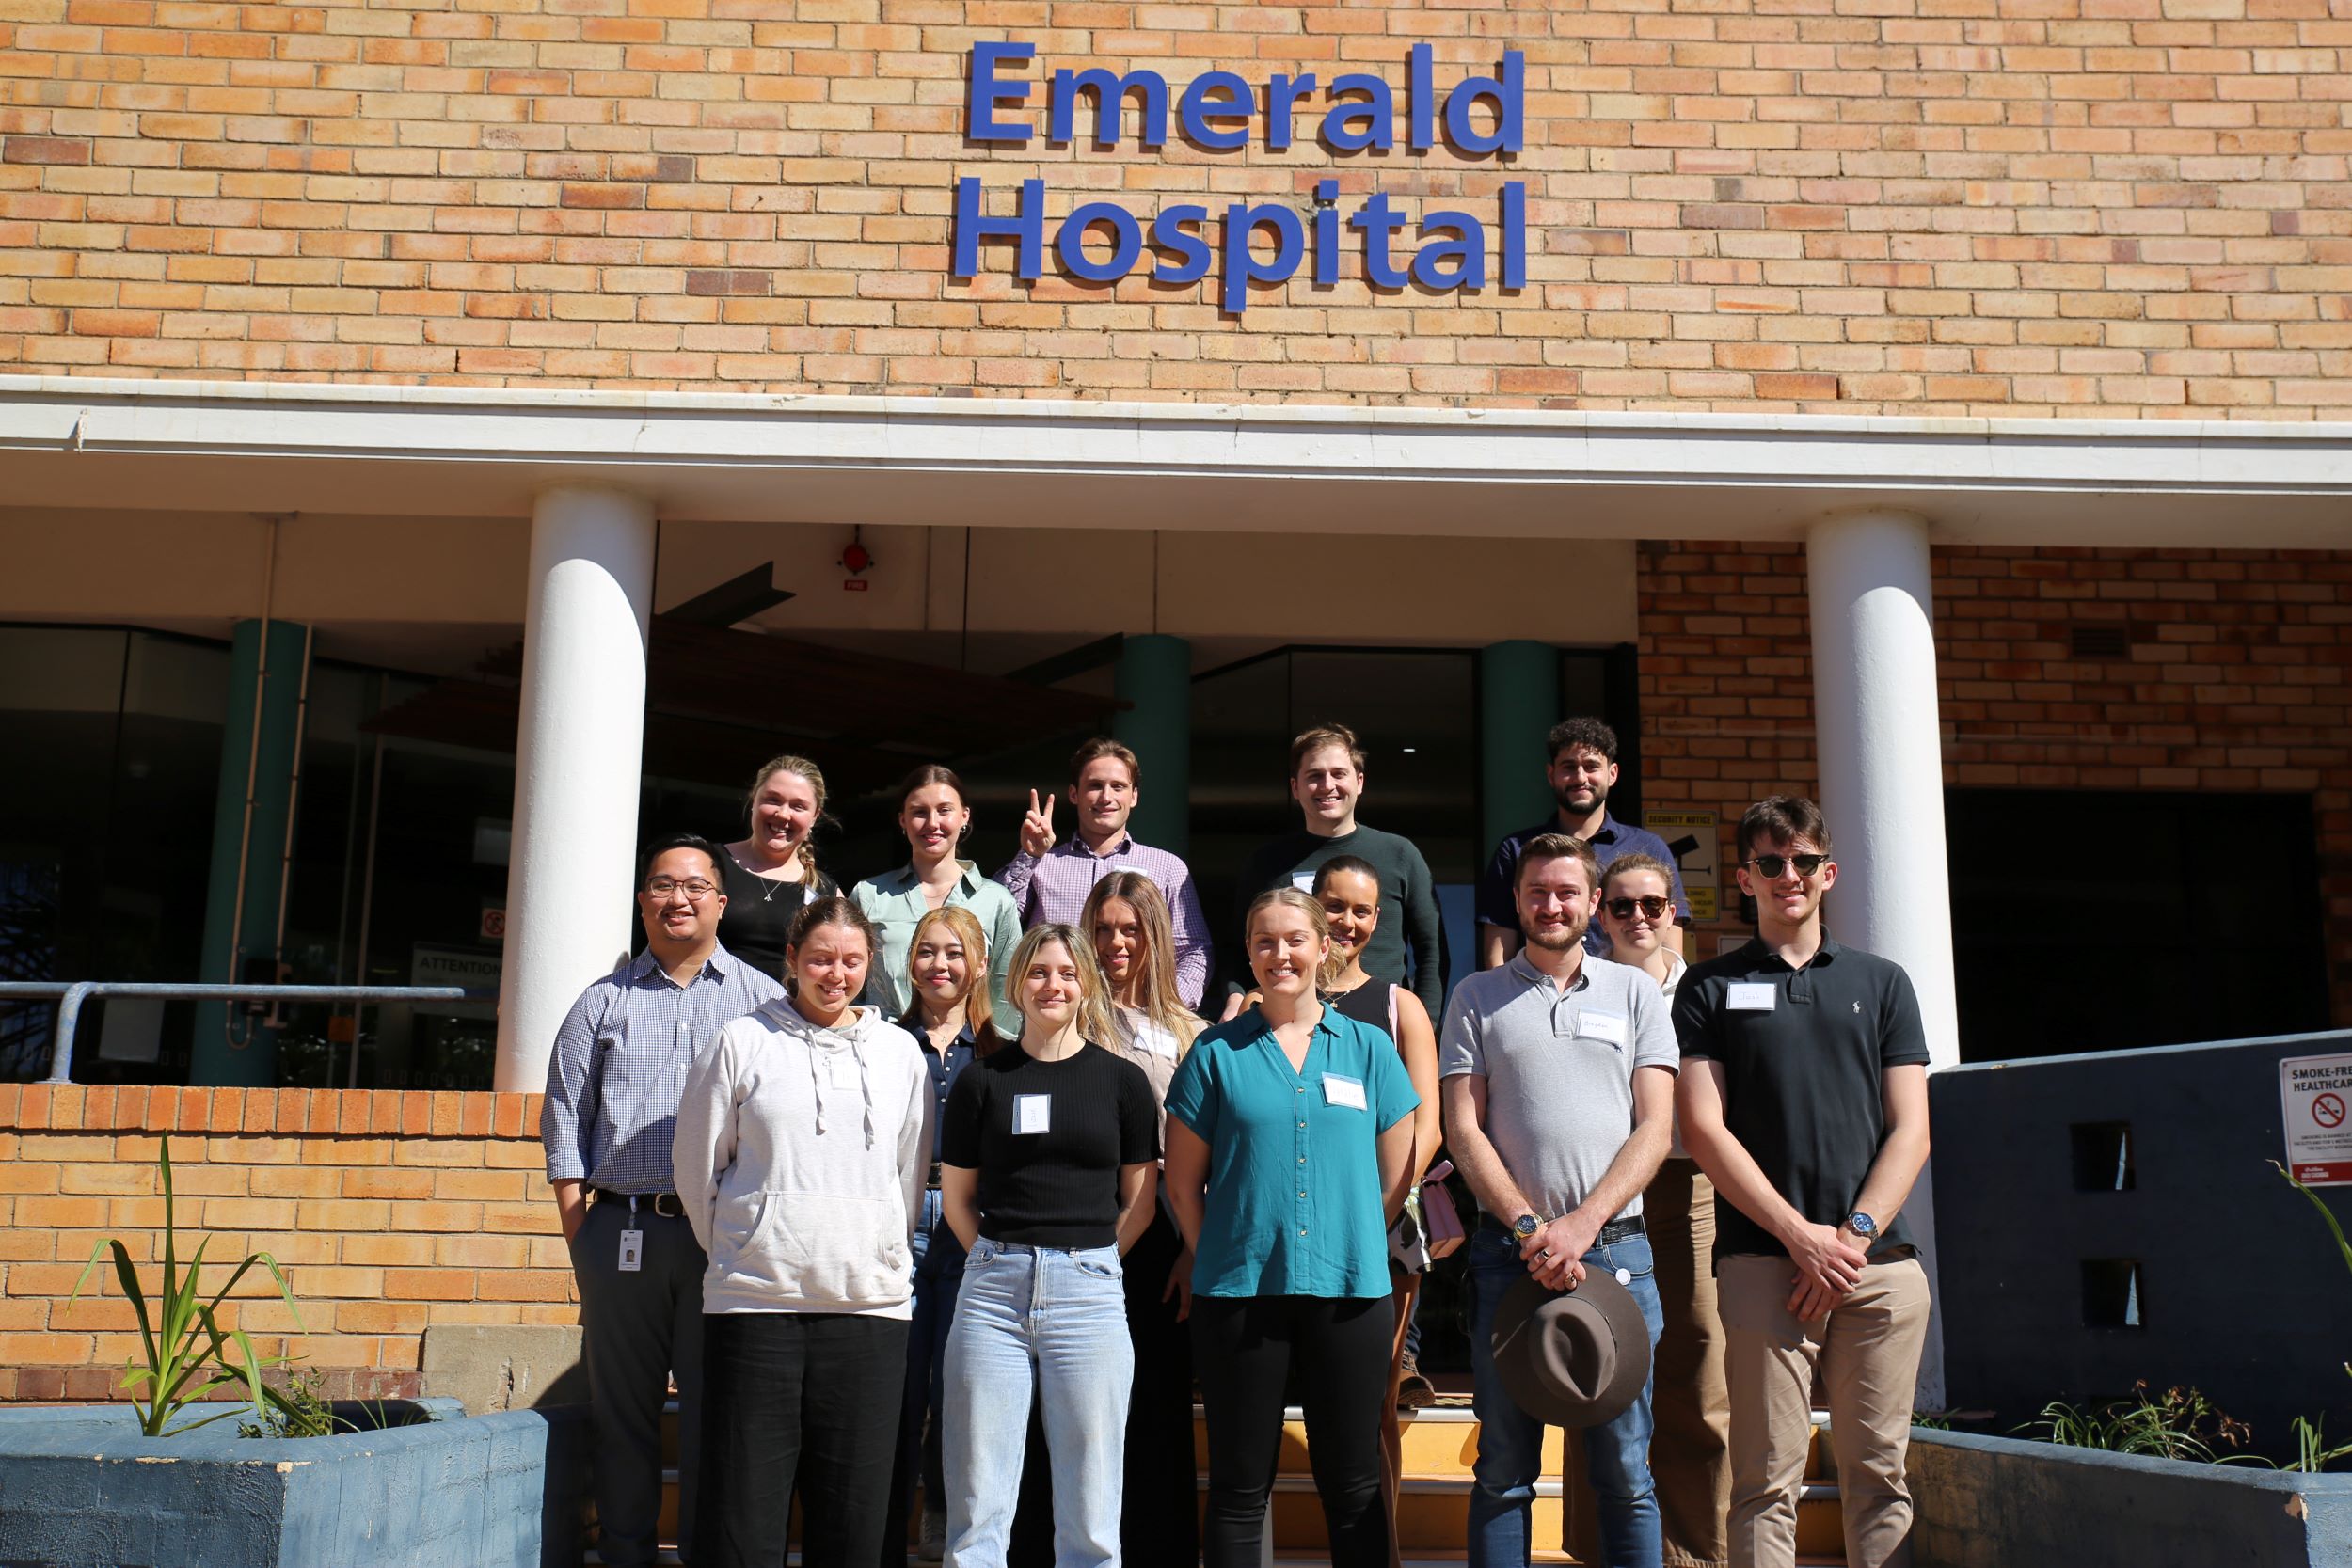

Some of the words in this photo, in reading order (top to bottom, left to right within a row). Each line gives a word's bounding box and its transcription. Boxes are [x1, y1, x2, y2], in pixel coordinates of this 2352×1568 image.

[969, 41, 1524, 154] Emerald
[955, 177, 1526, 312] Hospital
[1648, 815, 1683, 824] SECURITY
[1686, 816, 1711, 825] NOTICE
[420, 957, 501, 976] ATTENTION
